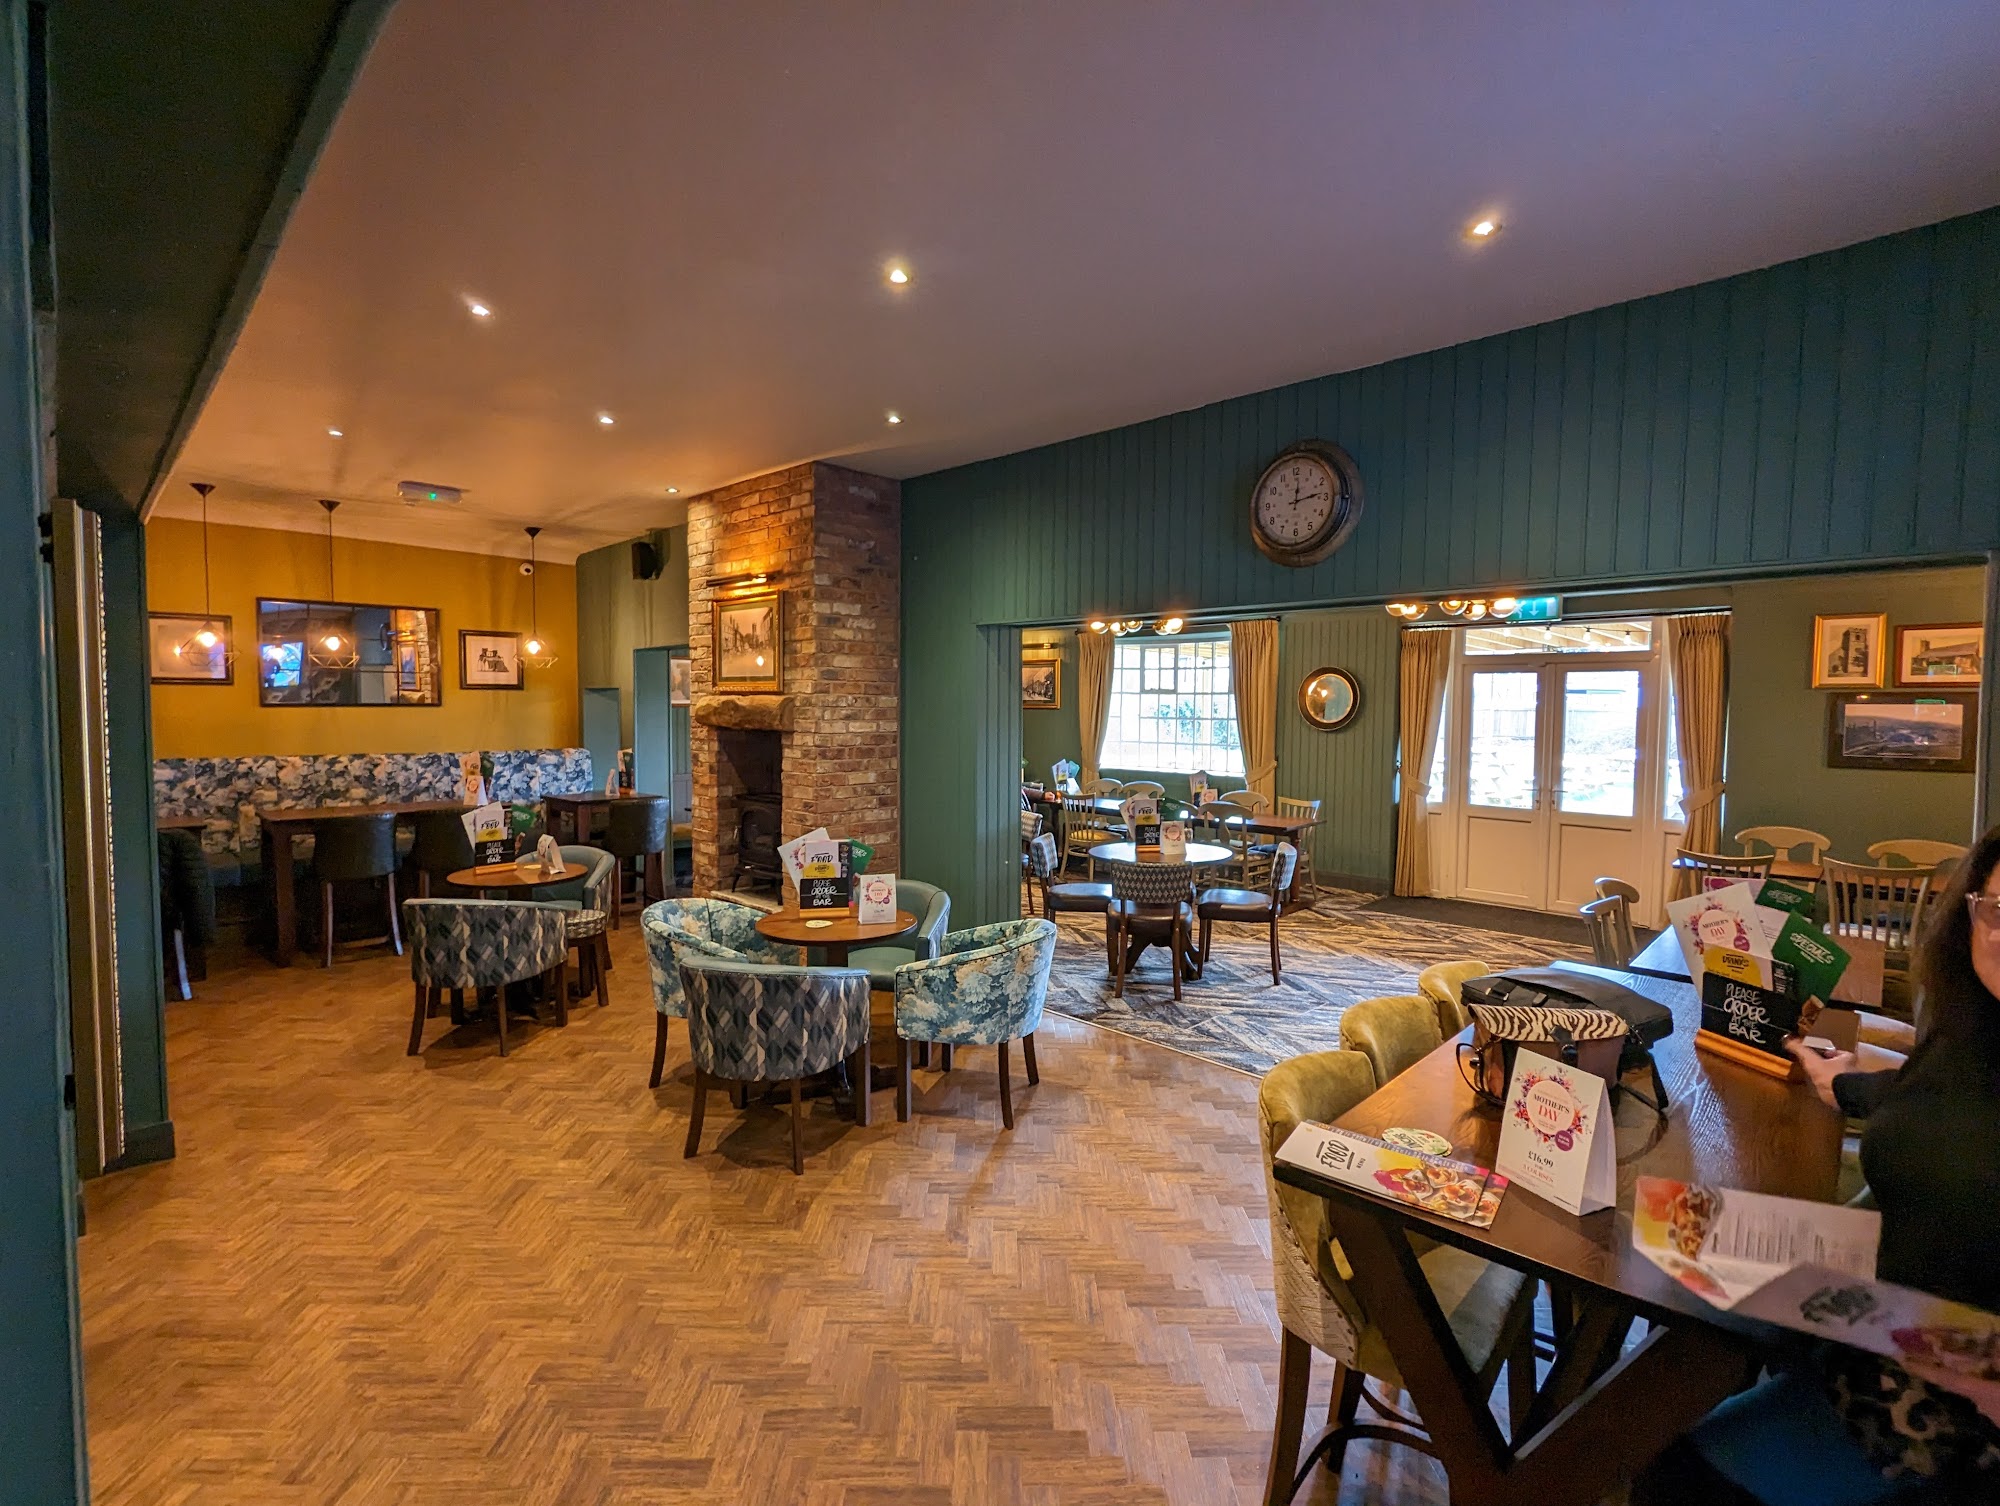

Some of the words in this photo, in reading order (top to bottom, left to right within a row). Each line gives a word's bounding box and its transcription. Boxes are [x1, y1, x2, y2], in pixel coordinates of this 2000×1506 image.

[1292, 467, 1300, 476] 12
[1309, 468, 1312, 476] 1
[1280, 474, 1285, 482] 11
[1319, 477, 1324, 486] 2
[1270, 487, 1276, 495] 10
[1324, 493, 1328, 501] 3
[1266, 502, 1270, 511] 9
[1318, 509, 1324, 517] 4
[1270, 517, 1274, 525] 8
[1280, 526, 1285, 534] 7
[1308, 522, 1313, 530] 5
[1293, 528, 1298, 536] 6
[811, 885, 838, 896] ORDER
[813, 898, 834, 907] BAR
[1789, 932, 1835, 964] SPECIALS
[1722, 955, 1750, 968] DRINKS
[1726, 982, 1762, 1005] PLEASE
[1723, 997, 1771, 1024] ORDER
[1728, 1022, 1767, 1044] BAR
[1533, 1093, 1570, 1114] MOTHER'S
[1538, 1104, 1560, 1122] DAY
[1320, 1139, 1350, 1170] FOOD
[1527, 1150, 1554, 1168] £16.99
